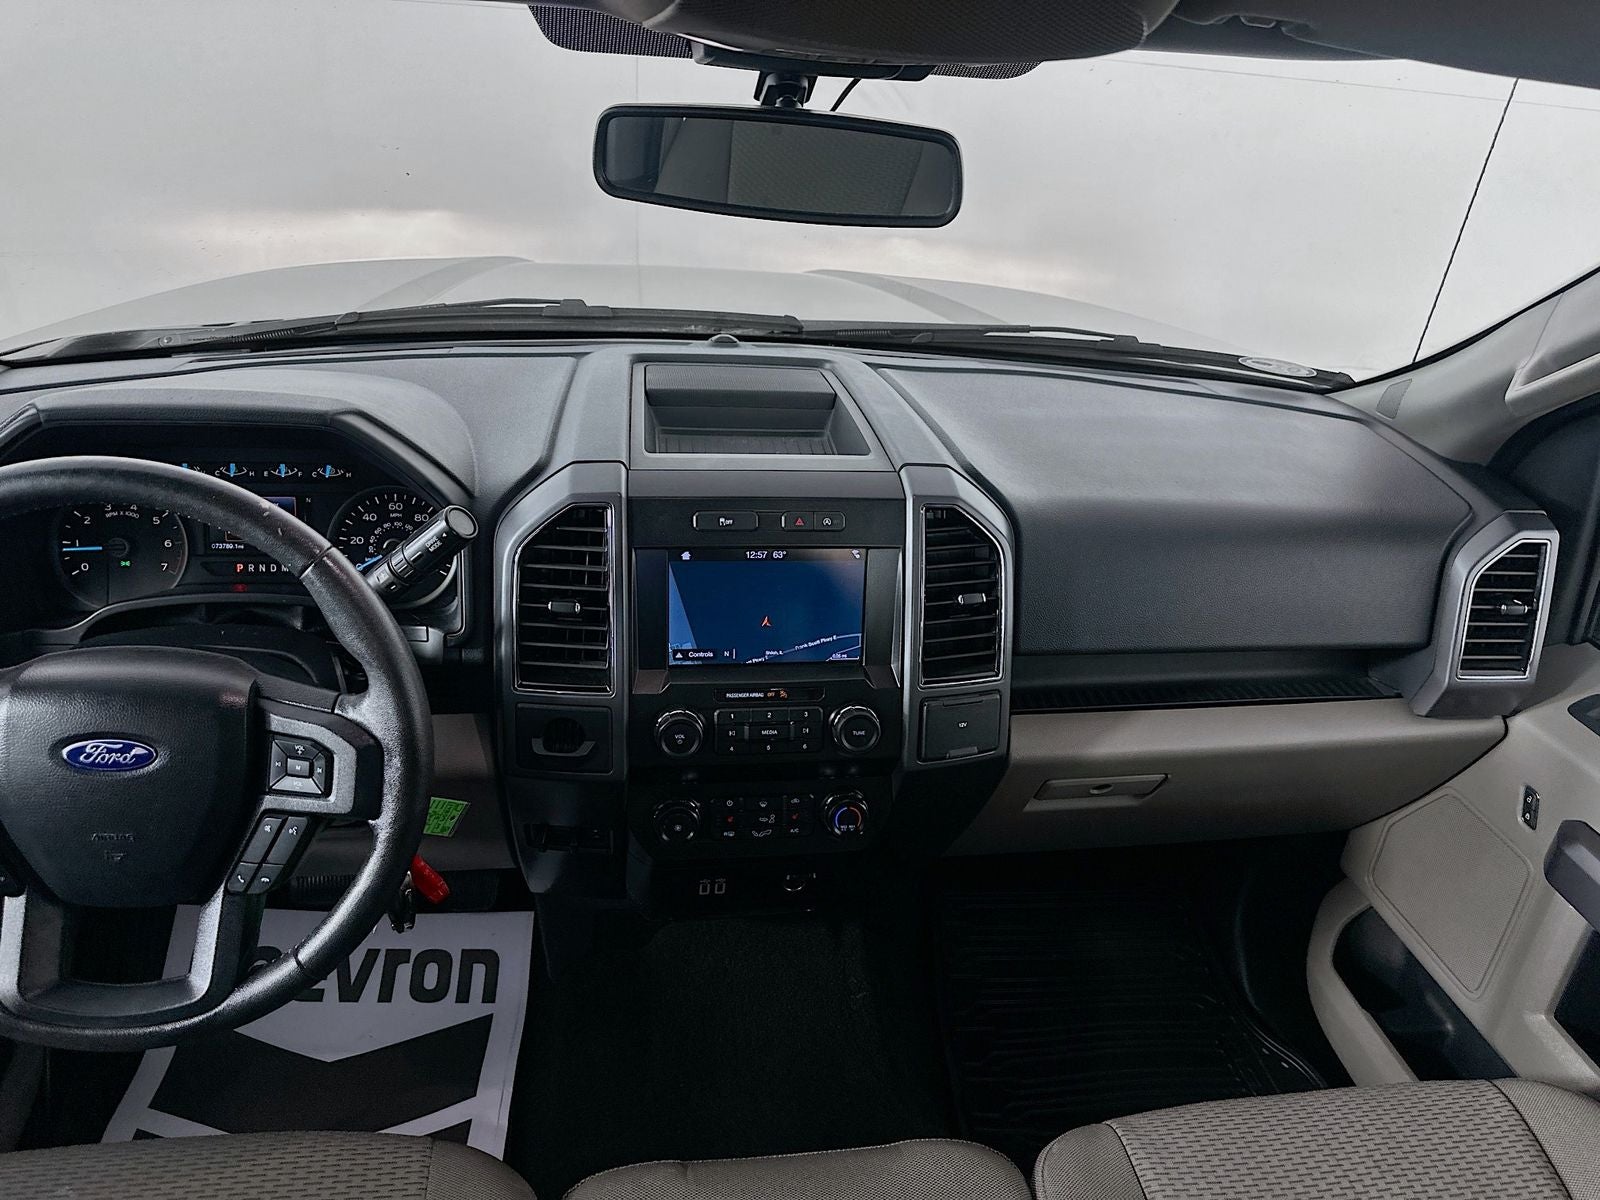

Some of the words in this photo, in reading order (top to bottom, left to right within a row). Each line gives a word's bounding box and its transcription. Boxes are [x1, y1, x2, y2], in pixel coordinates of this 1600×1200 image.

[388, 502, 403, 510] 60
[84, 516, 91, 524] 2
[152, 516, 160, 524] 5
[362, 513, 377, 521] 40
[164, 539, 172, 548] 6
[350, 536, 364, 544] 20
[428, 540, 442, 552] MODE
[745, 551, 767, 559] 12:57
[81, 562, 89, 571] 0
[161, 562, 168, 572] 7
[236, 564, 244, 572] P
[248, 564, 255, 572] R
[259, 564, 266, 572] N
[270, 564, 277, 572] D
[80, 743, 141, 764] Ford
